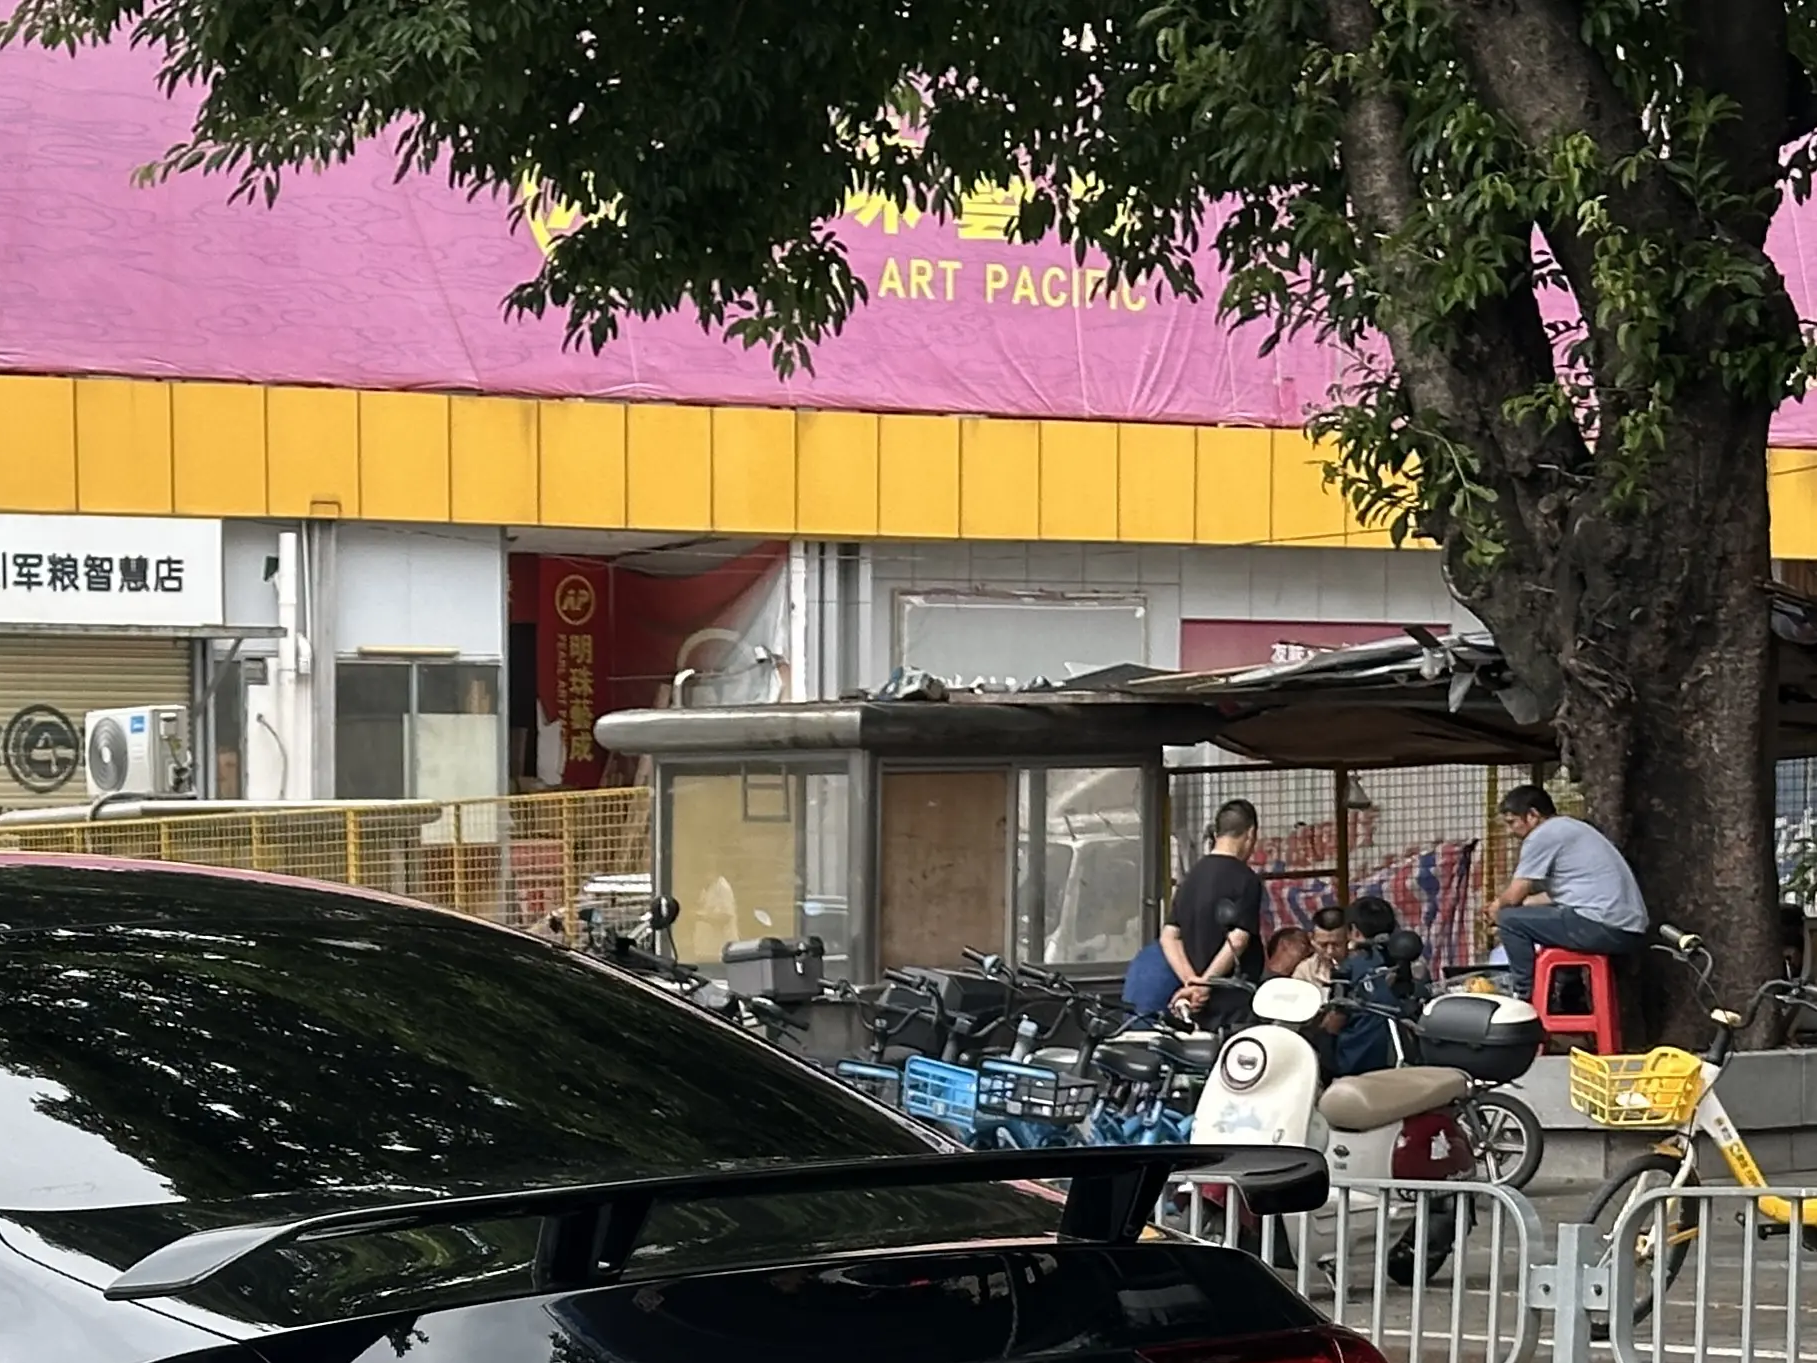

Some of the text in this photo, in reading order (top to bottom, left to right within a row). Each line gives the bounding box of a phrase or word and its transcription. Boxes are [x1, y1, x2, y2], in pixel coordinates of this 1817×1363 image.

[878, 257, 962, 300] ART
[569, 634, 594, 762] 明珠藝成
